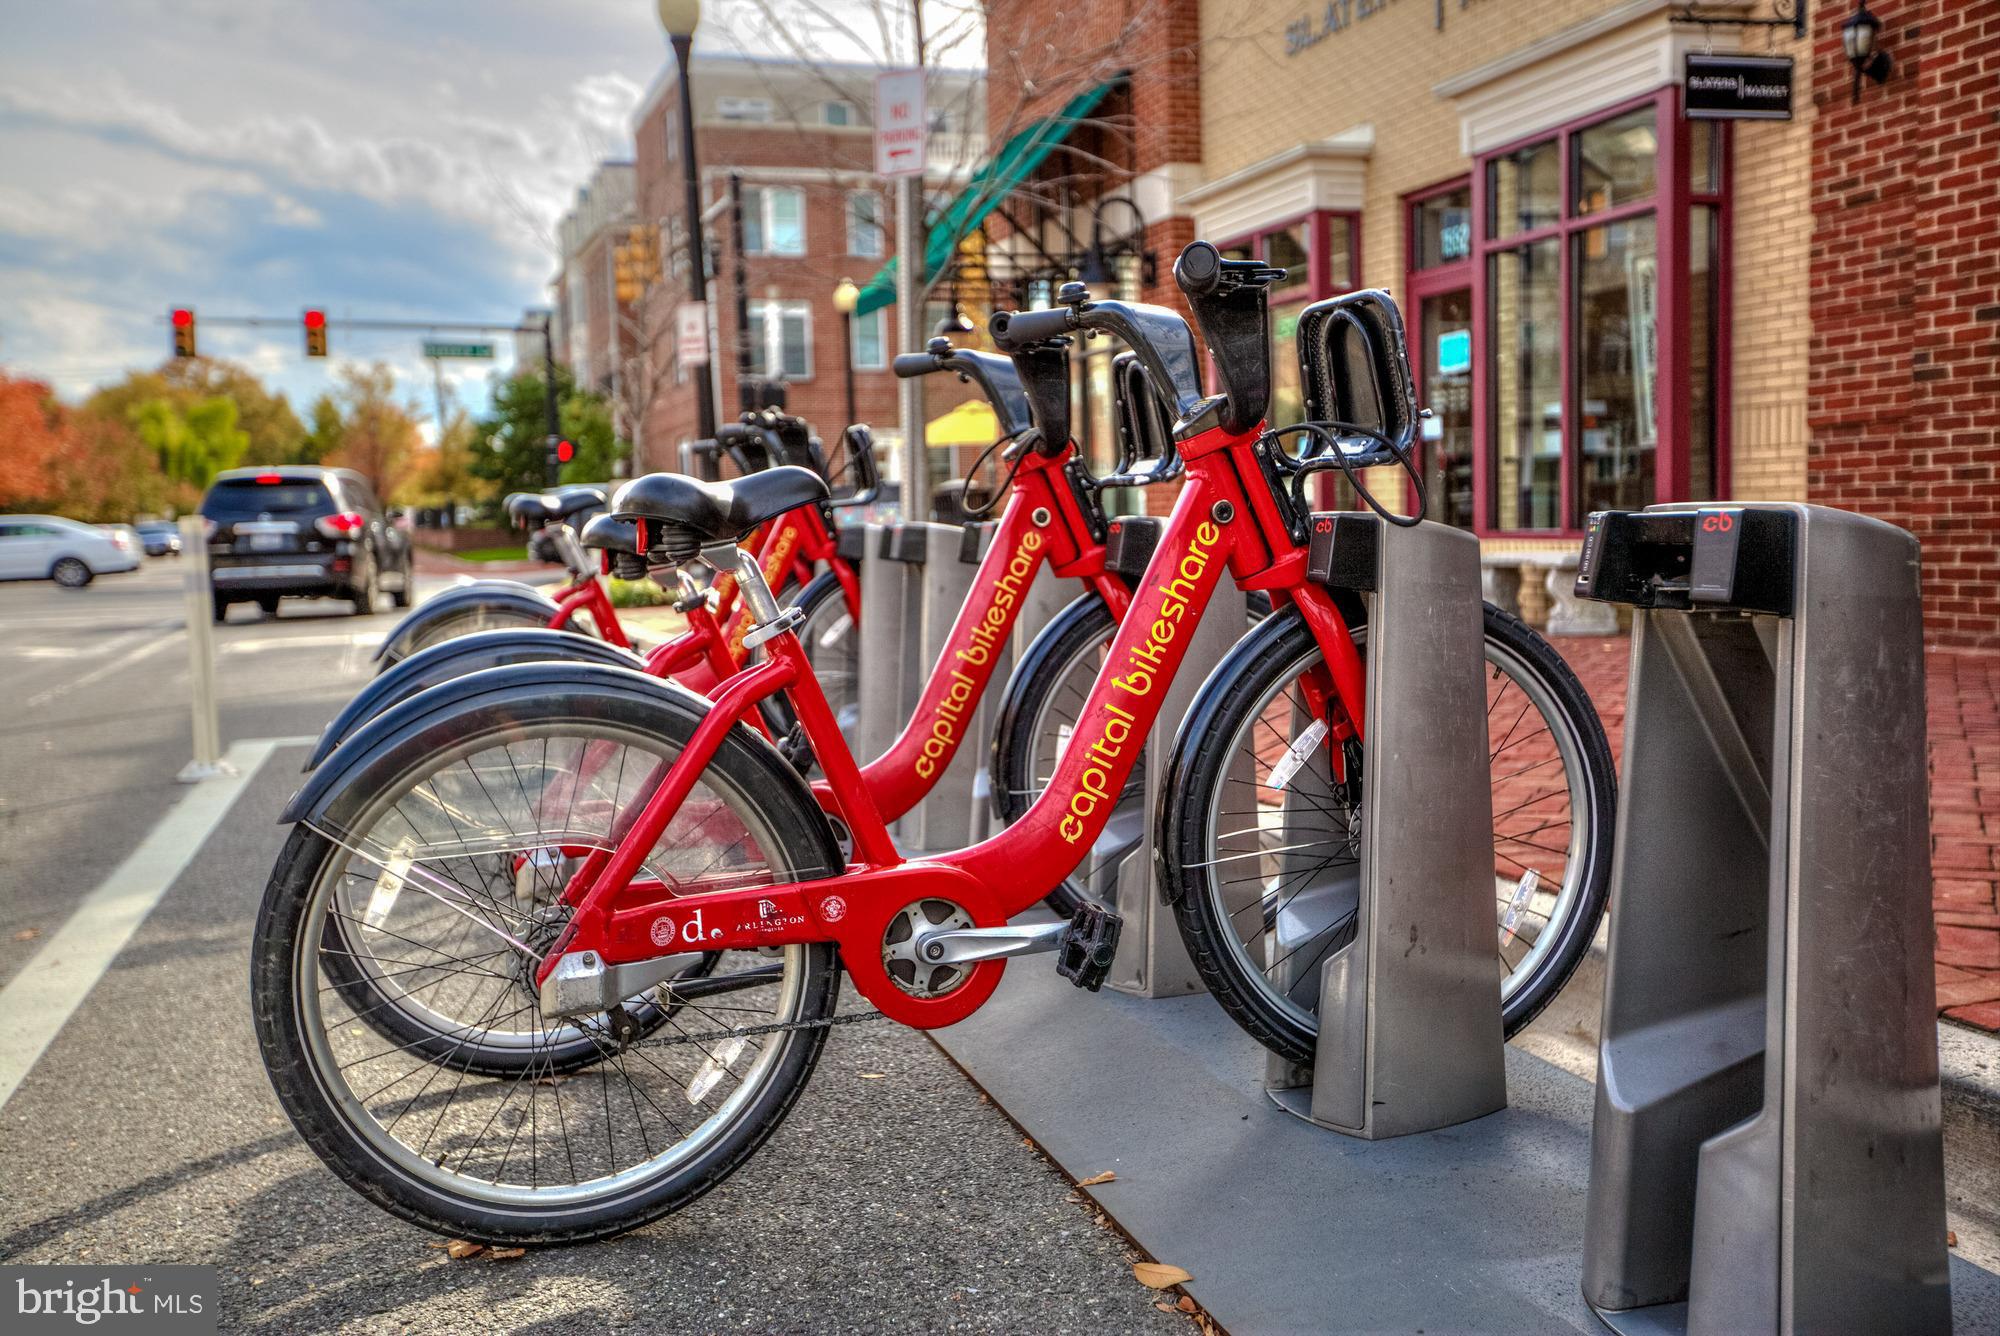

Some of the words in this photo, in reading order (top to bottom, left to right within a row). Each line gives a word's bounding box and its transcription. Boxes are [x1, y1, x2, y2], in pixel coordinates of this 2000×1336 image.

[1688, 76, 1738, 90] SLATERS
[1744, 84, 1789, 97] MARKET
[889, 103, 911, 120] NO
[880, 127, 921, 145] PARKING
[1315, 518, 1332, 533] cb
[1703, 512, 1733, 532] cb
[915, 670, 975, 779] capital
[956, 531, 1041, 665] bikeshare
[1060, 703, 1135, 844] capital
[1110, 521, 1219, 696] bikeshare
